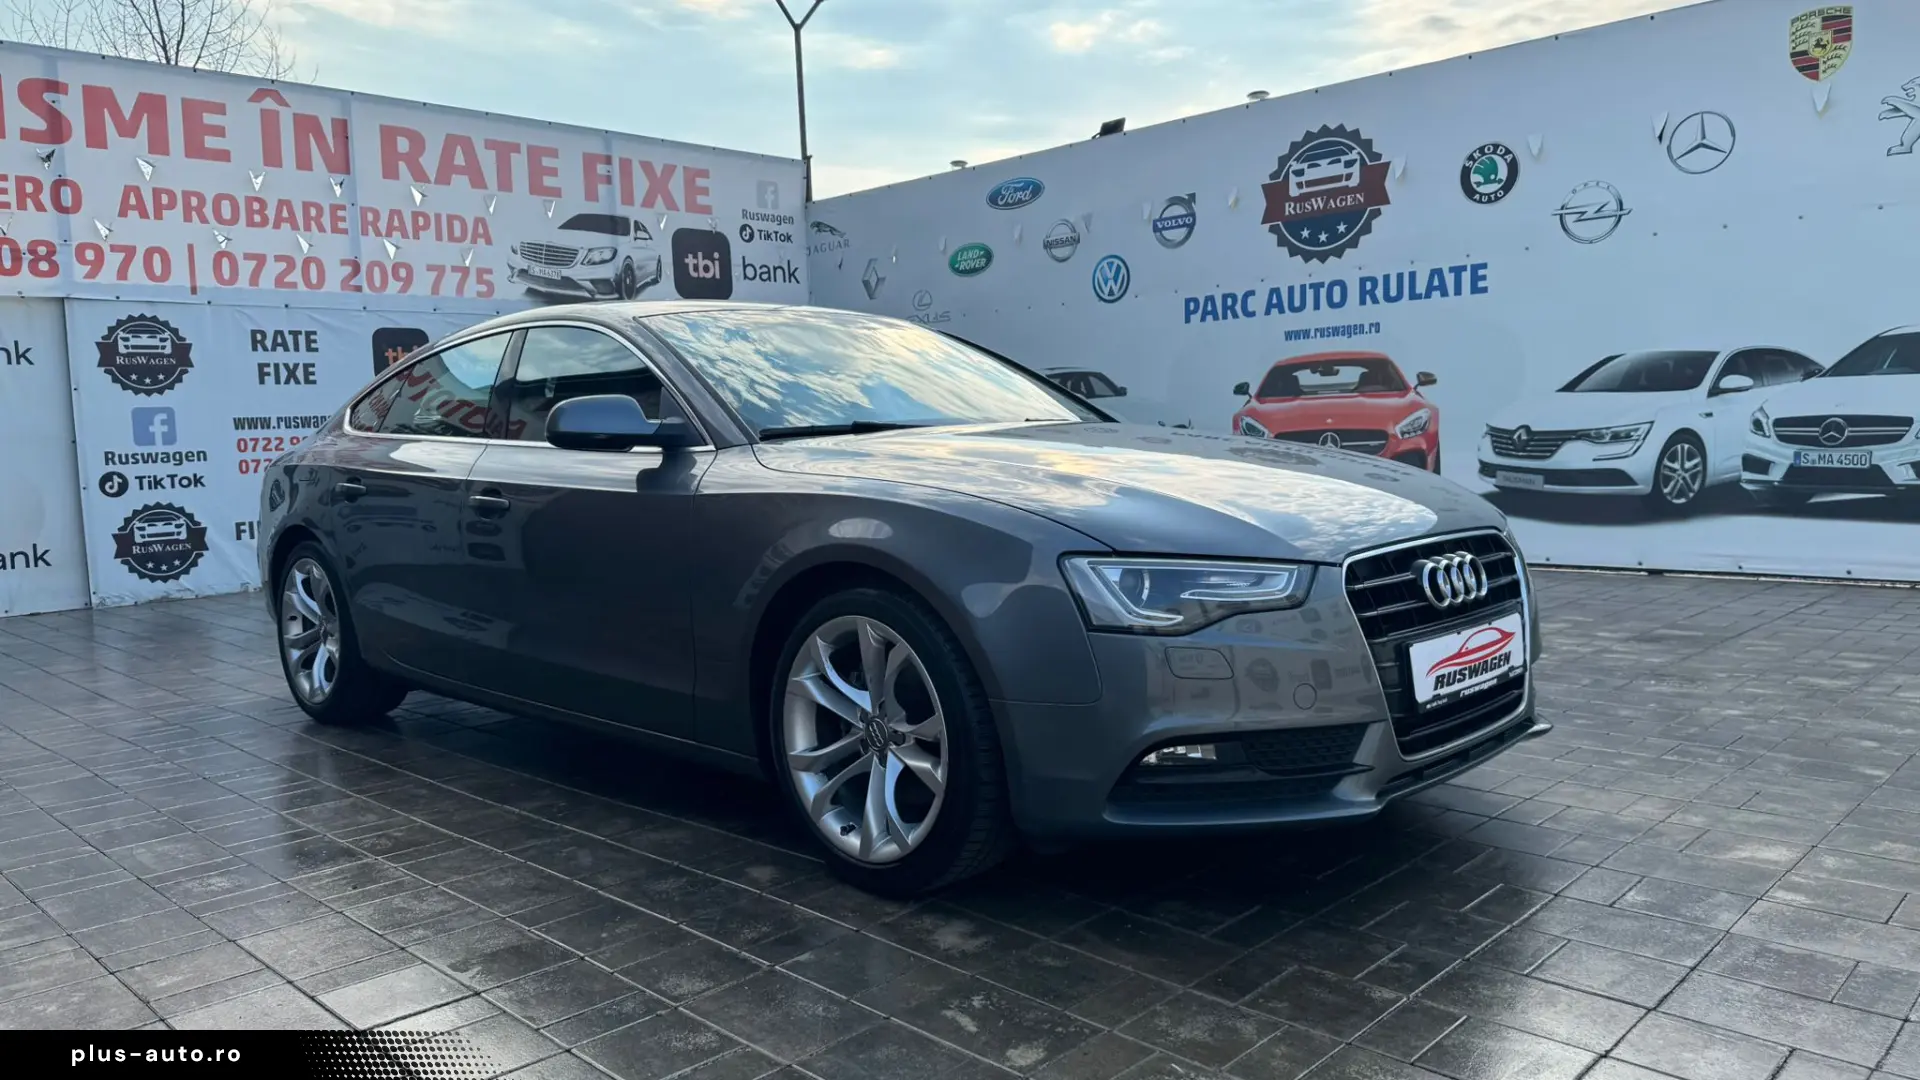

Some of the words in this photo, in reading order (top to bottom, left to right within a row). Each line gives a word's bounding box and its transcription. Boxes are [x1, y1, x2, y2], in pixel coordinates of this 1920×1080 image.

[0, 74, 231, 162] SME
[247, 88, 350, 175] ÎN
[379, 124, 563, 200] RATE
[582, 152, 714, 216] FIXE
[997, 182, 1033, 206] Ford
[1473, 189, 1505, 203] AUTO
[117, 184, 348, 234] APROBARE
[360, 205, 494, 247] RAPIDA
[742, 208, 794, 225] Ruswagen
[1156, 216, 1193, 228] VOLVO
[757, 229, 793, 244] TikTok
[1045, 235, 1077, 247] NISSAN
[805, 239, 850, 256] JAGUAR
[957, 249, 979, 261] LAND
[0, 236, 60, 279] 08
[74, 241, 172, 284] 970
[212, 250, 326, 292] 0720
[339, 256, 415, 294] 209
[426, 264, 495, 299] 775
[685, 252, 720, 279] tbi
[742, 256, 800, 284] bank
[959, 258, 987, 271] ROVER
[1184, 290, 1257, 324] PARC
[1264, 279, 1348, 317] AUTO
[1358, 262, 1489, 306] RULATE
[250, 329, 320, 353] RATE
[1284, 321, 1381, 342] www.ruswagen.ro
[257, 362, 318, 386] FIXE
[232, 415, 332, 431] www.ruswa
[236, 436, 285, 453] 0722
[103, 449, 208, 467] Ruswagen
[1818, 453, 1834, 466] MA
[1836, 453, 1868, 467] 4500
[135, 473, 206, 492] TikTok
[235, 520, 261, 541] FI
[1433, 650, 1512, 691] RUSWAGEN
